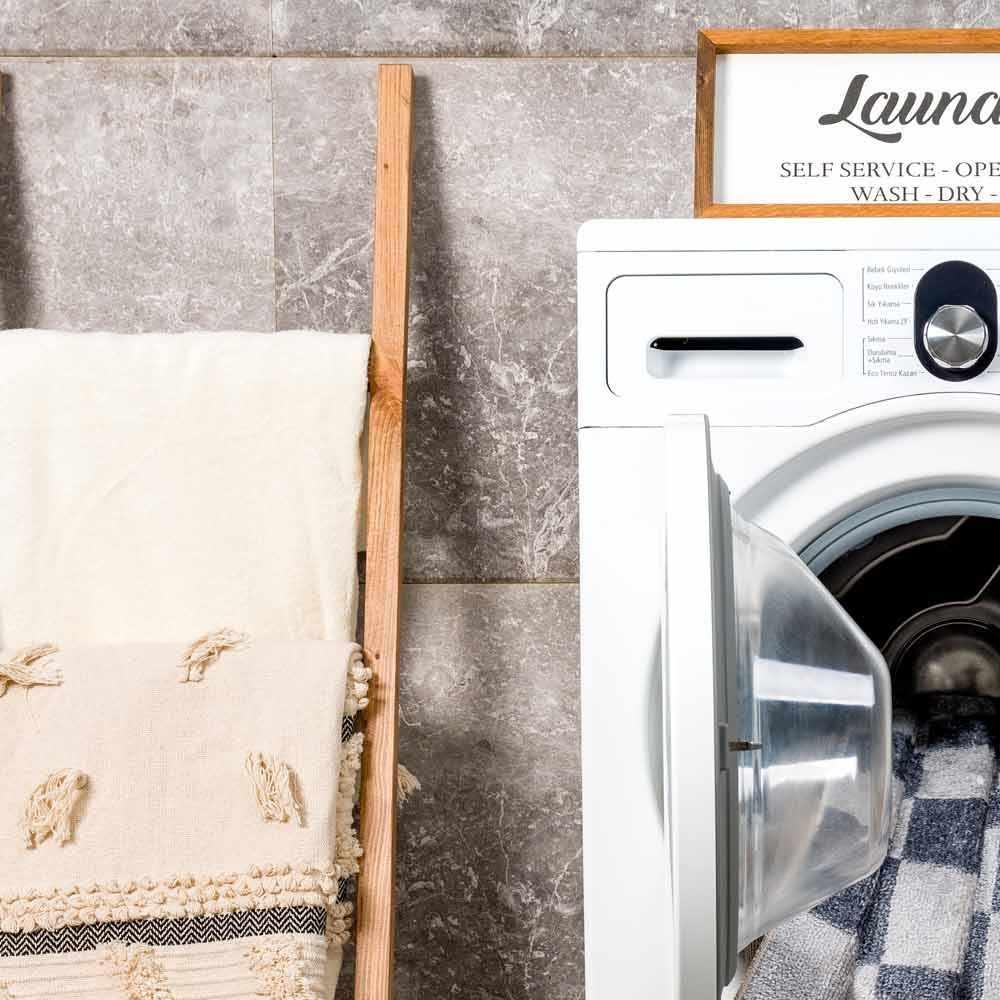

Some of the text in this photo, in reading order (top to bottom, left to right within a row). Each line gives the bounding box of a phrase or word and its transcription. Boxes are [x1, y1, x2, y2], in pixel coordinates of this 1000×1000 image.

[780, 161, 834, 178] SELF
[839, 161, 936, 178] SERVICE
[849, 185, 919, 202] WASH
[937, 185, 985, 202] DRY
